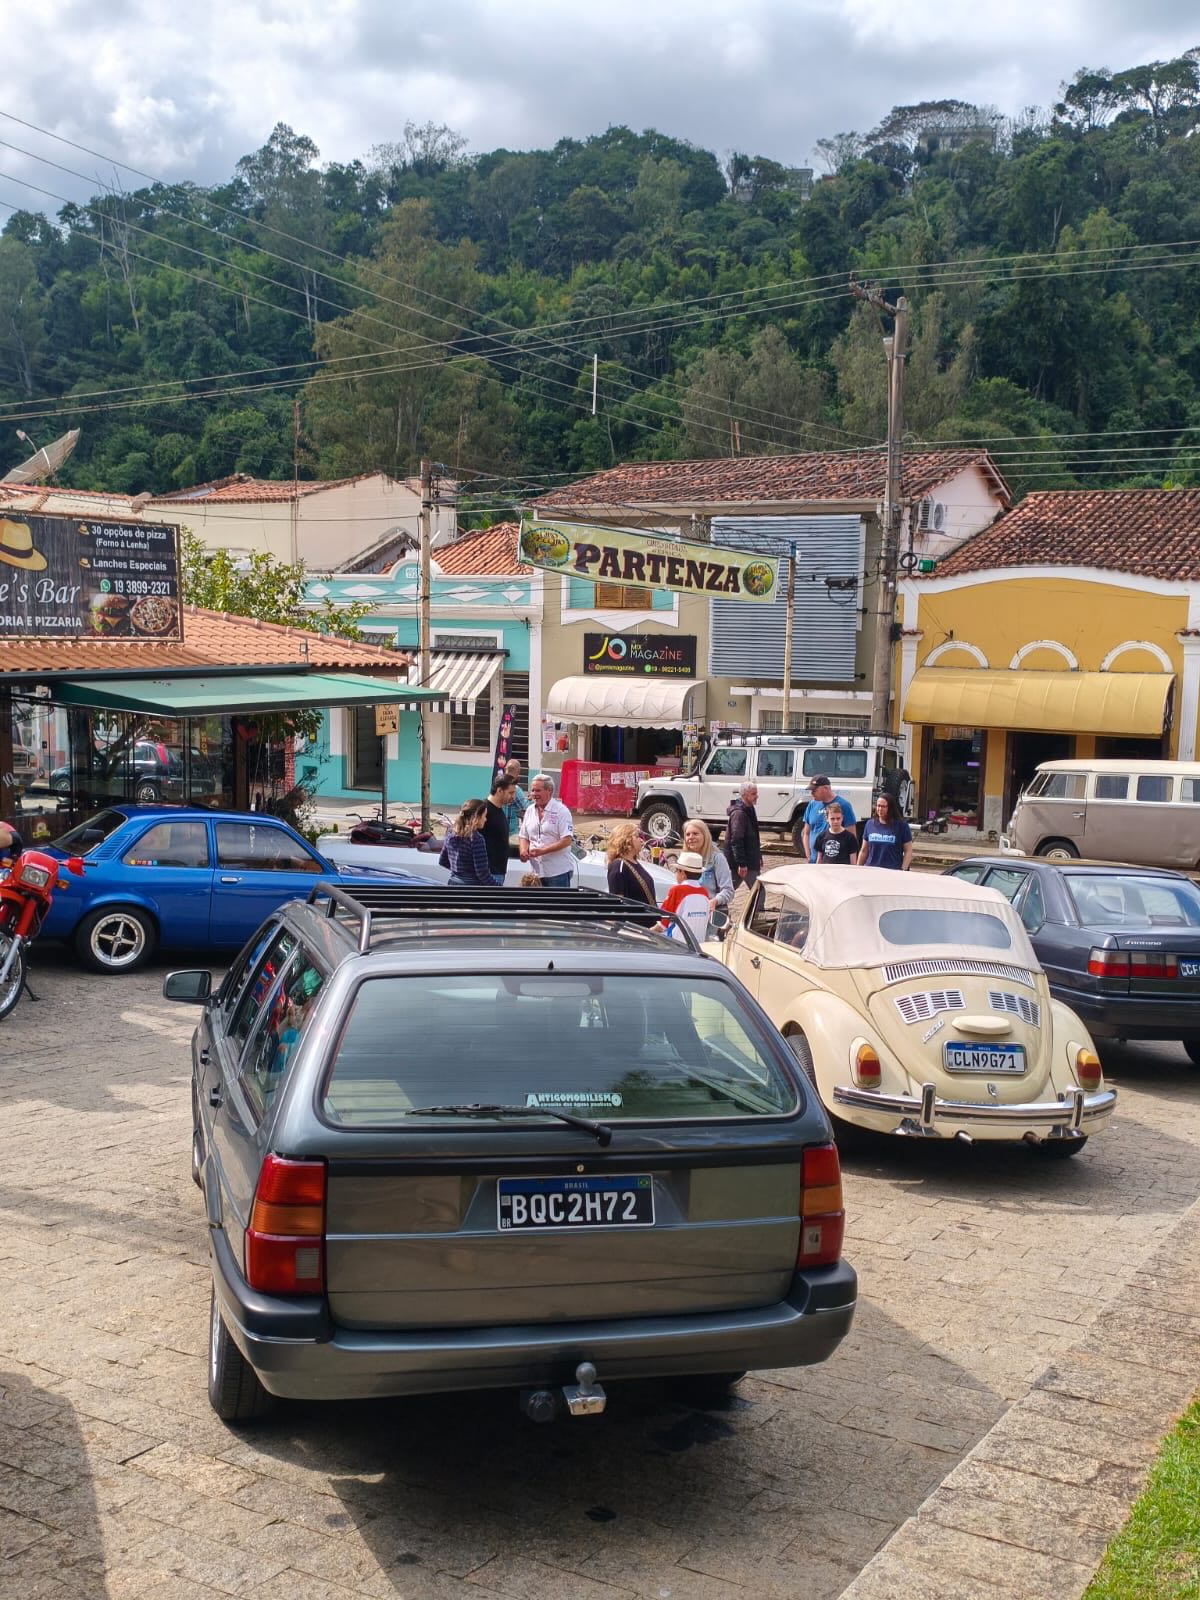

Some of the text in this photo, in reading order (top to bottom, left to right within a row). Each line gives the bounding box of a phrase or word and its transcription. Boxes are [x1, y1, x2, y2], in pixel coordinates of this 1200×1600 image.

[91, 525, 167, 540] 30 opções de pizza
[93, 558, 167, 571] Lanches Especiais
[573, 542, 741, 593] PARTENZA
[35, 578, 81, 604] Bar
[114, 580, 170, 594] 19 3899-2321
[27, 616, 33, 626] E
[35, 616, 83, 627] PIZZARIA
[1185, 963, 1200, 975] CF
[954, 1052, 1017, 1069] CLN9G71
[526, 1093, 622, 1107] ANTIGOMOBILISMO
[512, 1192, 638, 1225] BQC2H72
[501, 1217, 511, 1228] BR
